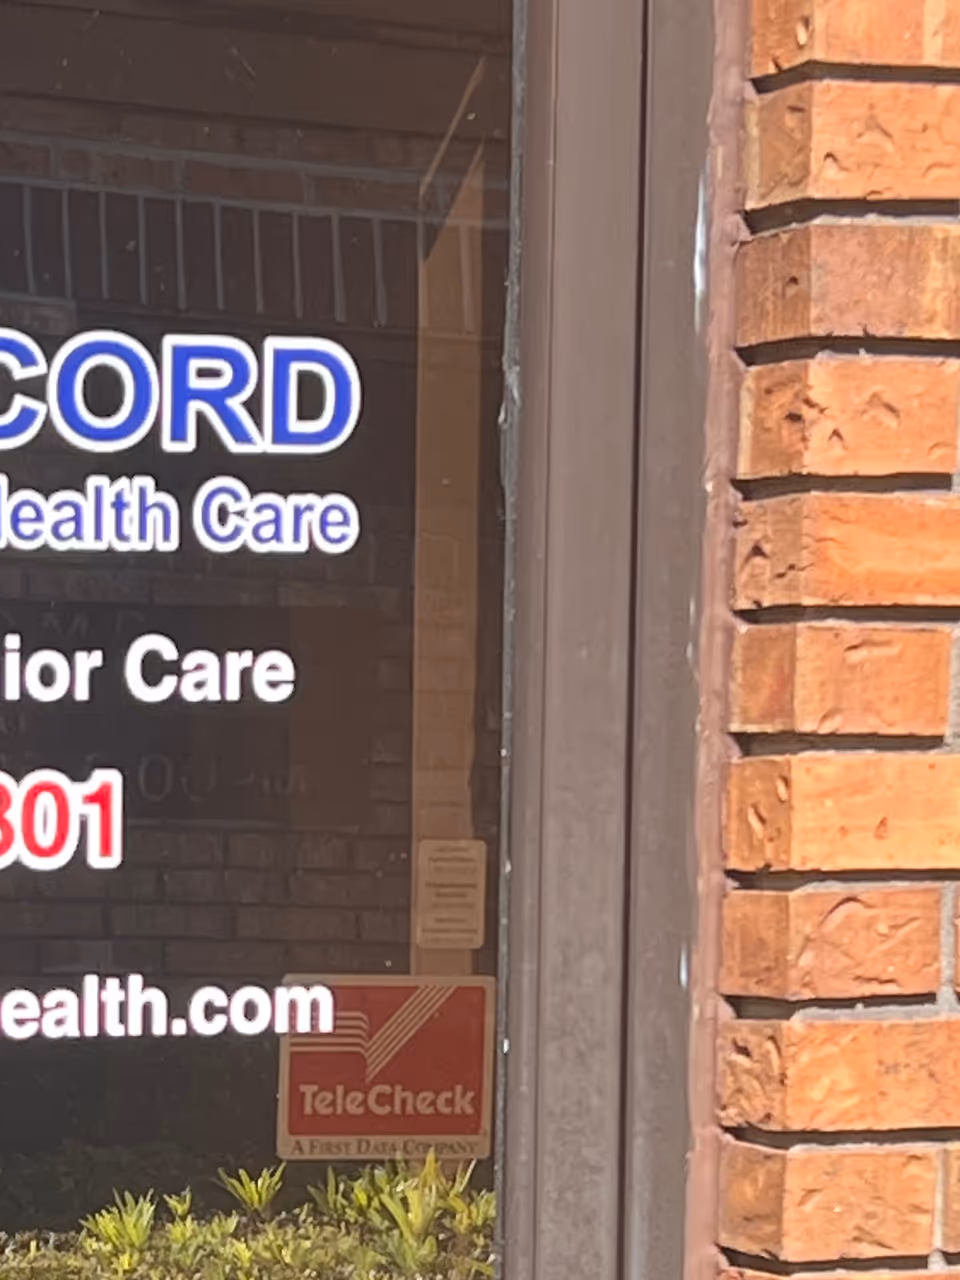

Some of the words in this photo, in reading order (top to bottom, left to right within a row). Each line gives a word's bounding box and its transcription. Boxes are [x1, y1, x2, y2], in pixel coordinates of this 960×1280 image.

[193, 476, 359, 553] Care
[125, 634, 294, 702] Care
[298, 1084, 476, 1116] TeleCheck
[290, 1139, 305, 1156] A
[308, 1138, 354, 1156] FIRST
[356, 1138, 398, 1156] DATA
[401, 1138, 480, 1157] COMPANY
